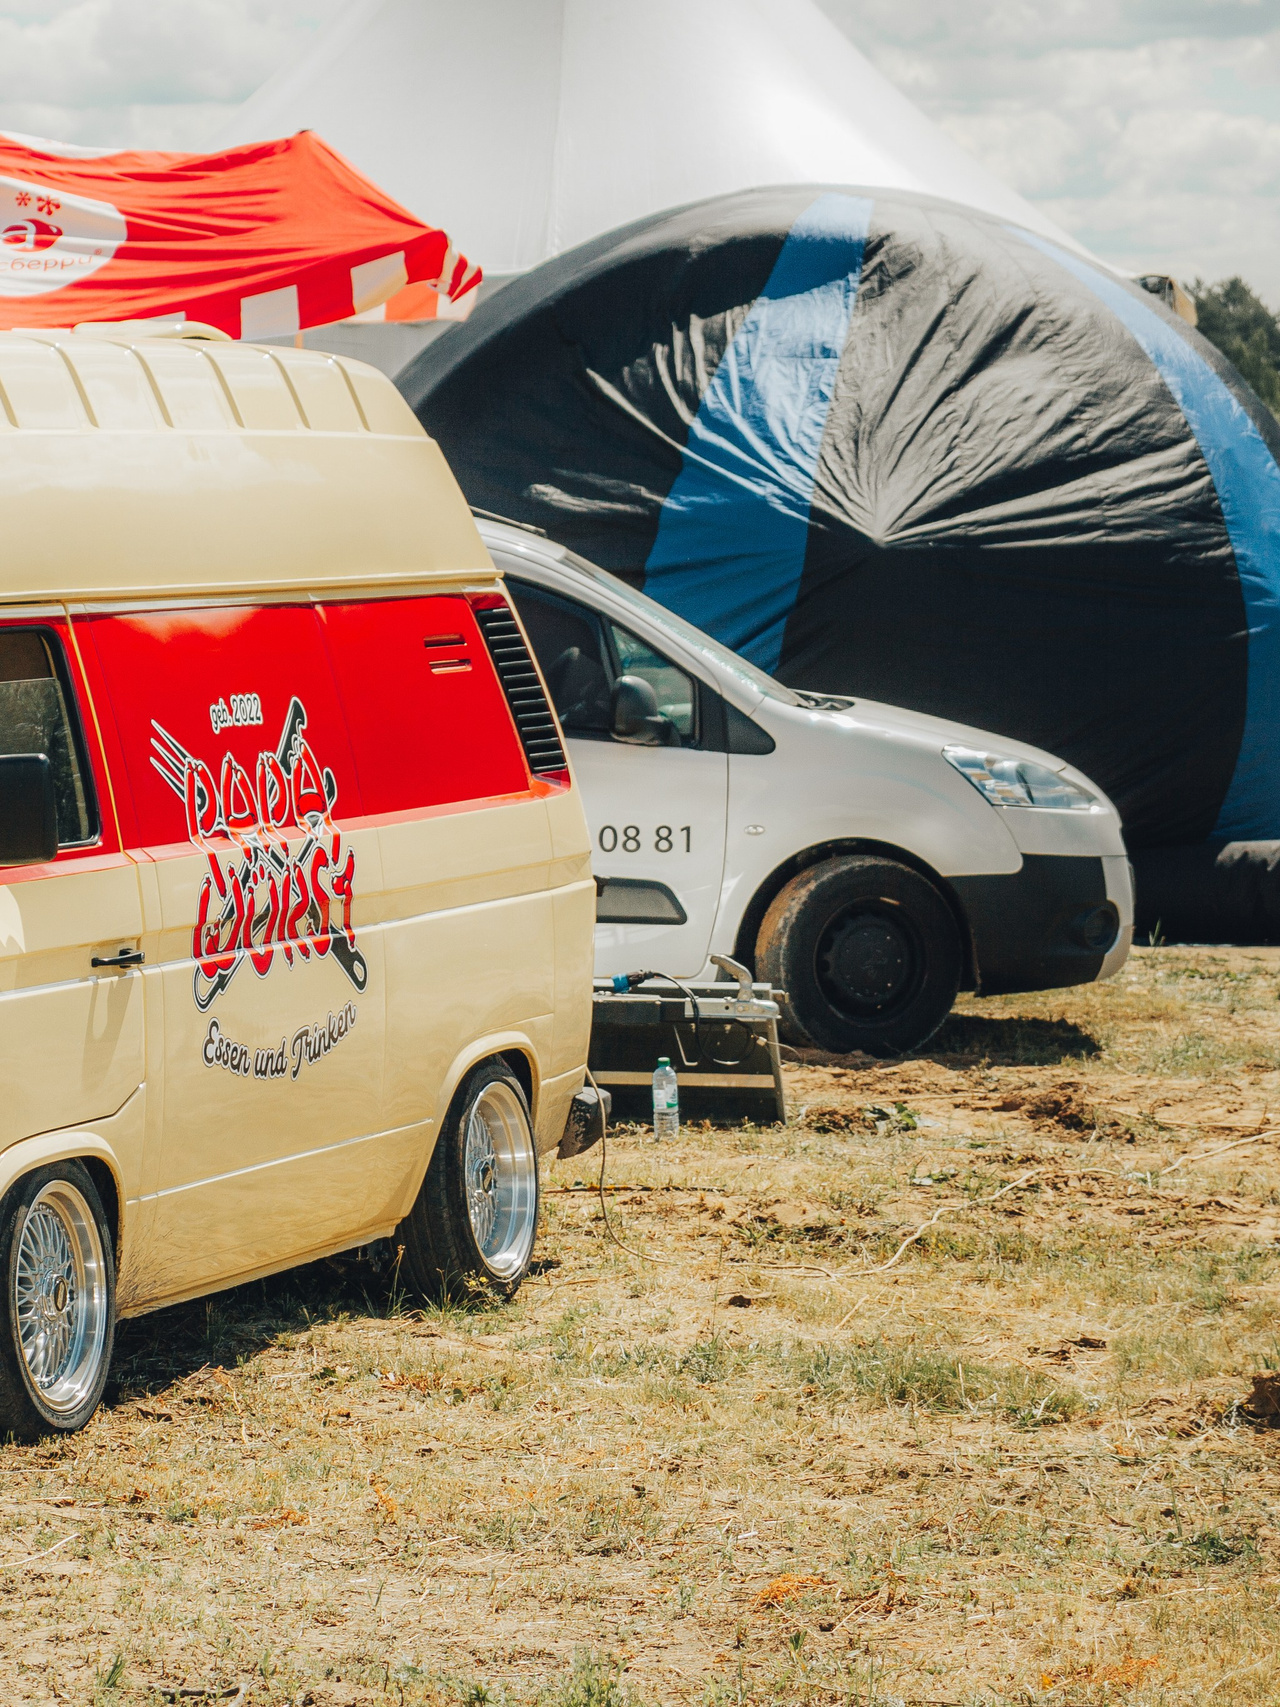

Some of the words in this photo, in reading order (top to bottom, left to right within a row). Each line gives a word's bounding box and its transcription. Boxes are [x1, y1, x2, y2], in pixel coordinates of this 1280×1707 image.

[231, 694, 262, 726] 2022
[184, 736, 342, 898] PAPA
[598, 825, 641, 853] 08
[654, 825, 691, 853] 81
[203, 1017, 251, 1076] Essen
[255, 1037, 288, 1079] und
[291, 1000, 357, 1081] Trinken
